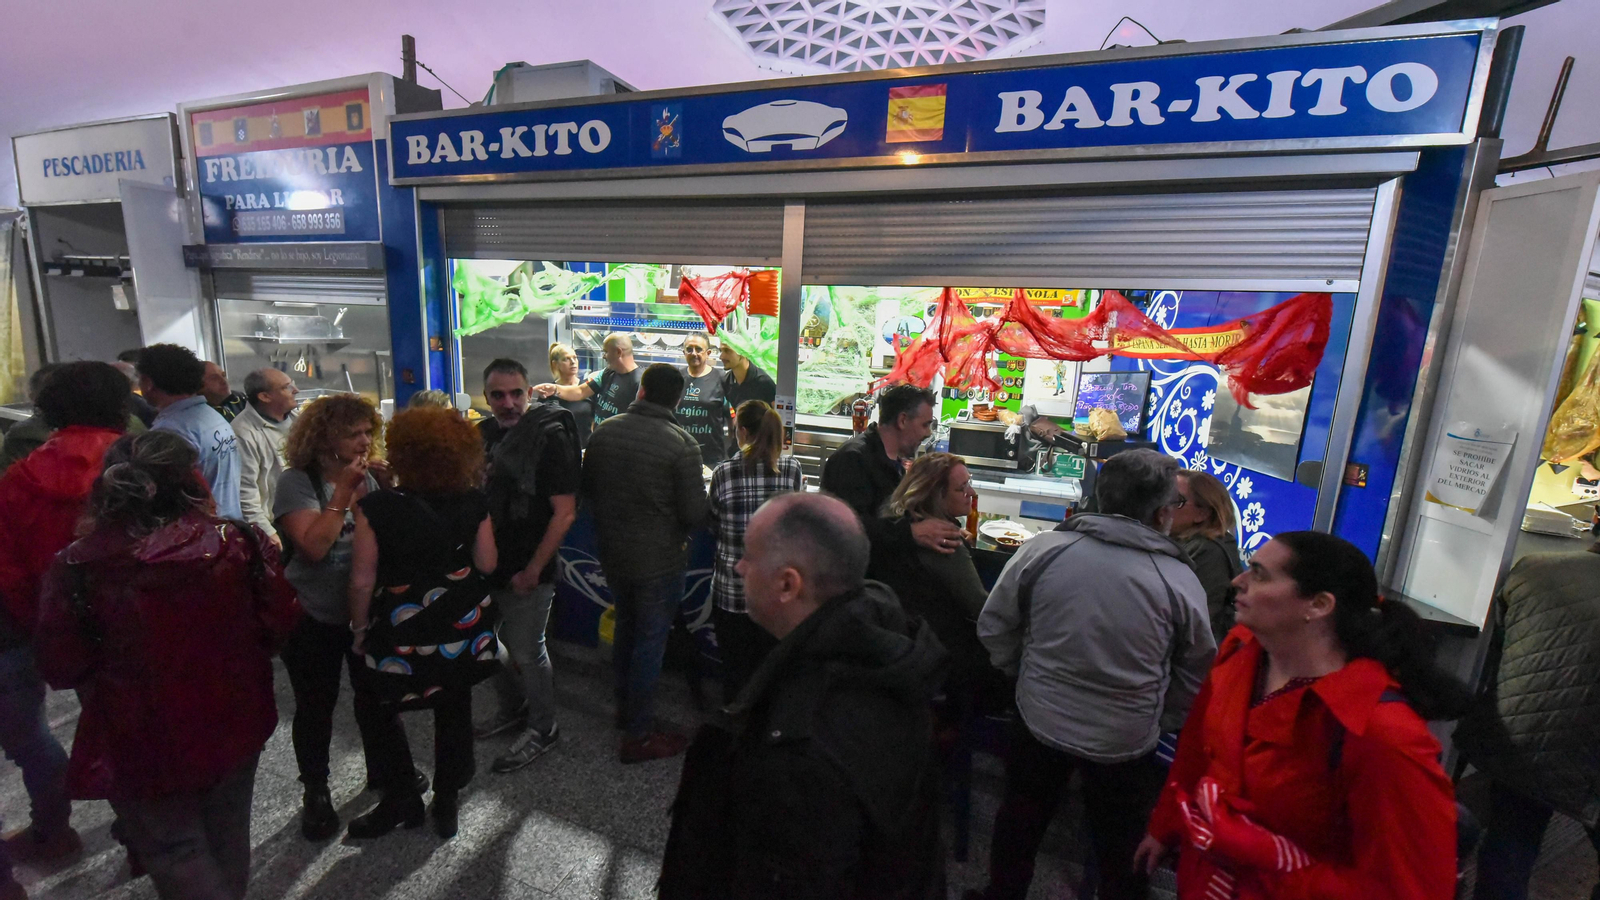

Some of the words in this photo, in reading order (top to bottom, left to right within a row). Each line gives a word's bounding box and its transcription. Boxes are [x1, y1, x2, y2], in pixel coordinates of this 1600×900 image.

[995, 62, 1439, 132] BAR-KITO
[406, 119, 611, 164] BAR-KITO
[43, 149, 146, 177] PESCADERIA
[225, 193, 270, 210] PARA
[272, 215, 286, 229] 406
[291, 214, 306, 230] 658
[307, 213, 323, 229] 993
[324, 212, 340, 229] 356
[1183, 337, 1207, 348] HASTA
[1210, 333, 1241, 348] MORIR
[675, 405, 708, 418] Legión
[1449, 464, 1479, 477] VIDRIOS
[1480, 472, 1490, 480] AL
[1459, 459, 1485, 470] SACAR
[1437, 477, 1452, 486] DEL
[1454, 482, 1487, 496] MERCAD
[1448, 472, 1486, 487] EXTERIOR
